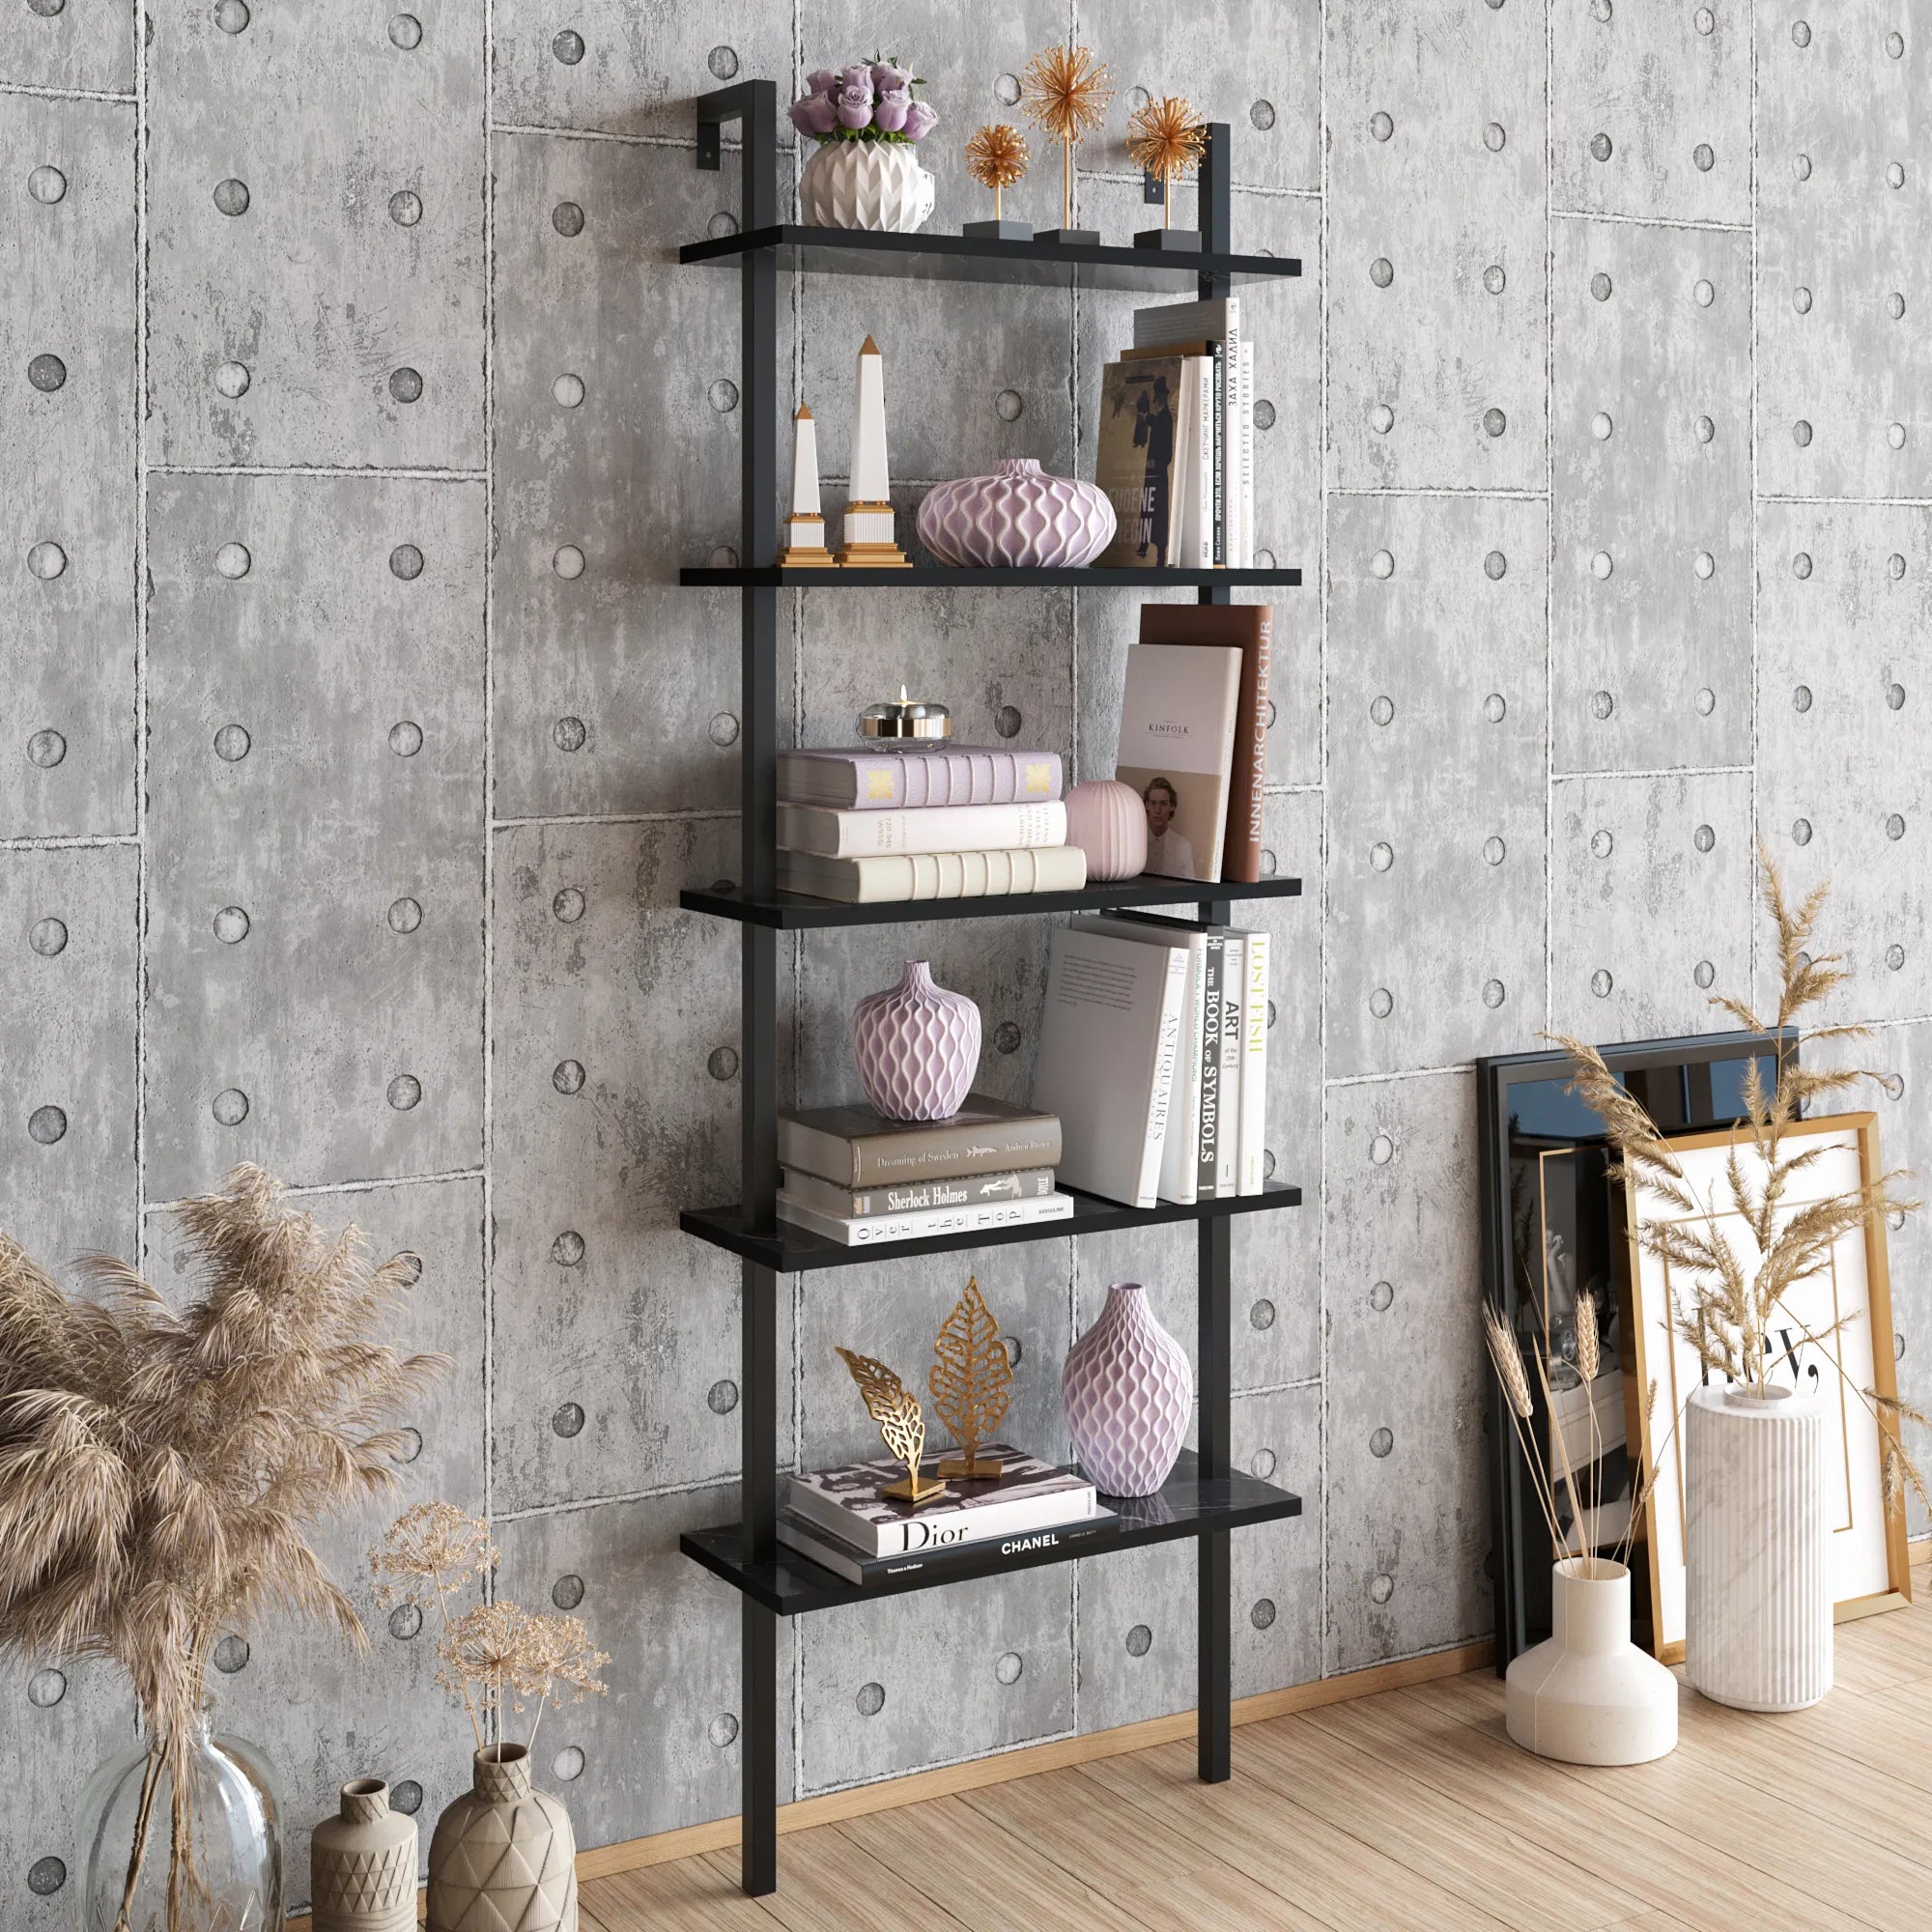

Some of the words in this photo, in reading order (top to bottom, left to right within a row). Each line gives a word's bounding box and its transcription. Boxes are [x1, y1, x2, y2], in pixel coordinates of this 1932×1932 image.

[1228, 377, 1237, 407] ЗАХА
[1109, 486, 1156, 512] EUGENE
[1114, 518, 1152, 544] NEGIN
[1149, 724, 1189, 734] KINFOLK
[1249, 621, 1271, 842] INNENARCHITEKTUR
[1251, 942, 1265, 998] LOST
[1205, 990, 1220, 1046] BOOK
[1225, 1001, 1239, 1039] ART
[1249, 1005, 1264, 1052] FISH
[1152, 1014, 1178, 1141] ANTIQUAIRES
[1201, 1066, 1217, 1163] SYMBOLS
[877, 1154, 918, 1168] Dreaming
[918, 1151, 926, 1163] of
[927, 1150, 959, 1162] Sweden
[1005, 1142, 1030, 1152] Andrew
[888, 1189, 929, 1211] Sherlock
[933, 1185, 968, 1206] Holmes
[897, 1521, 969, 1551] Dior
[1002, 1533, 1060, 1555] CHANEL
